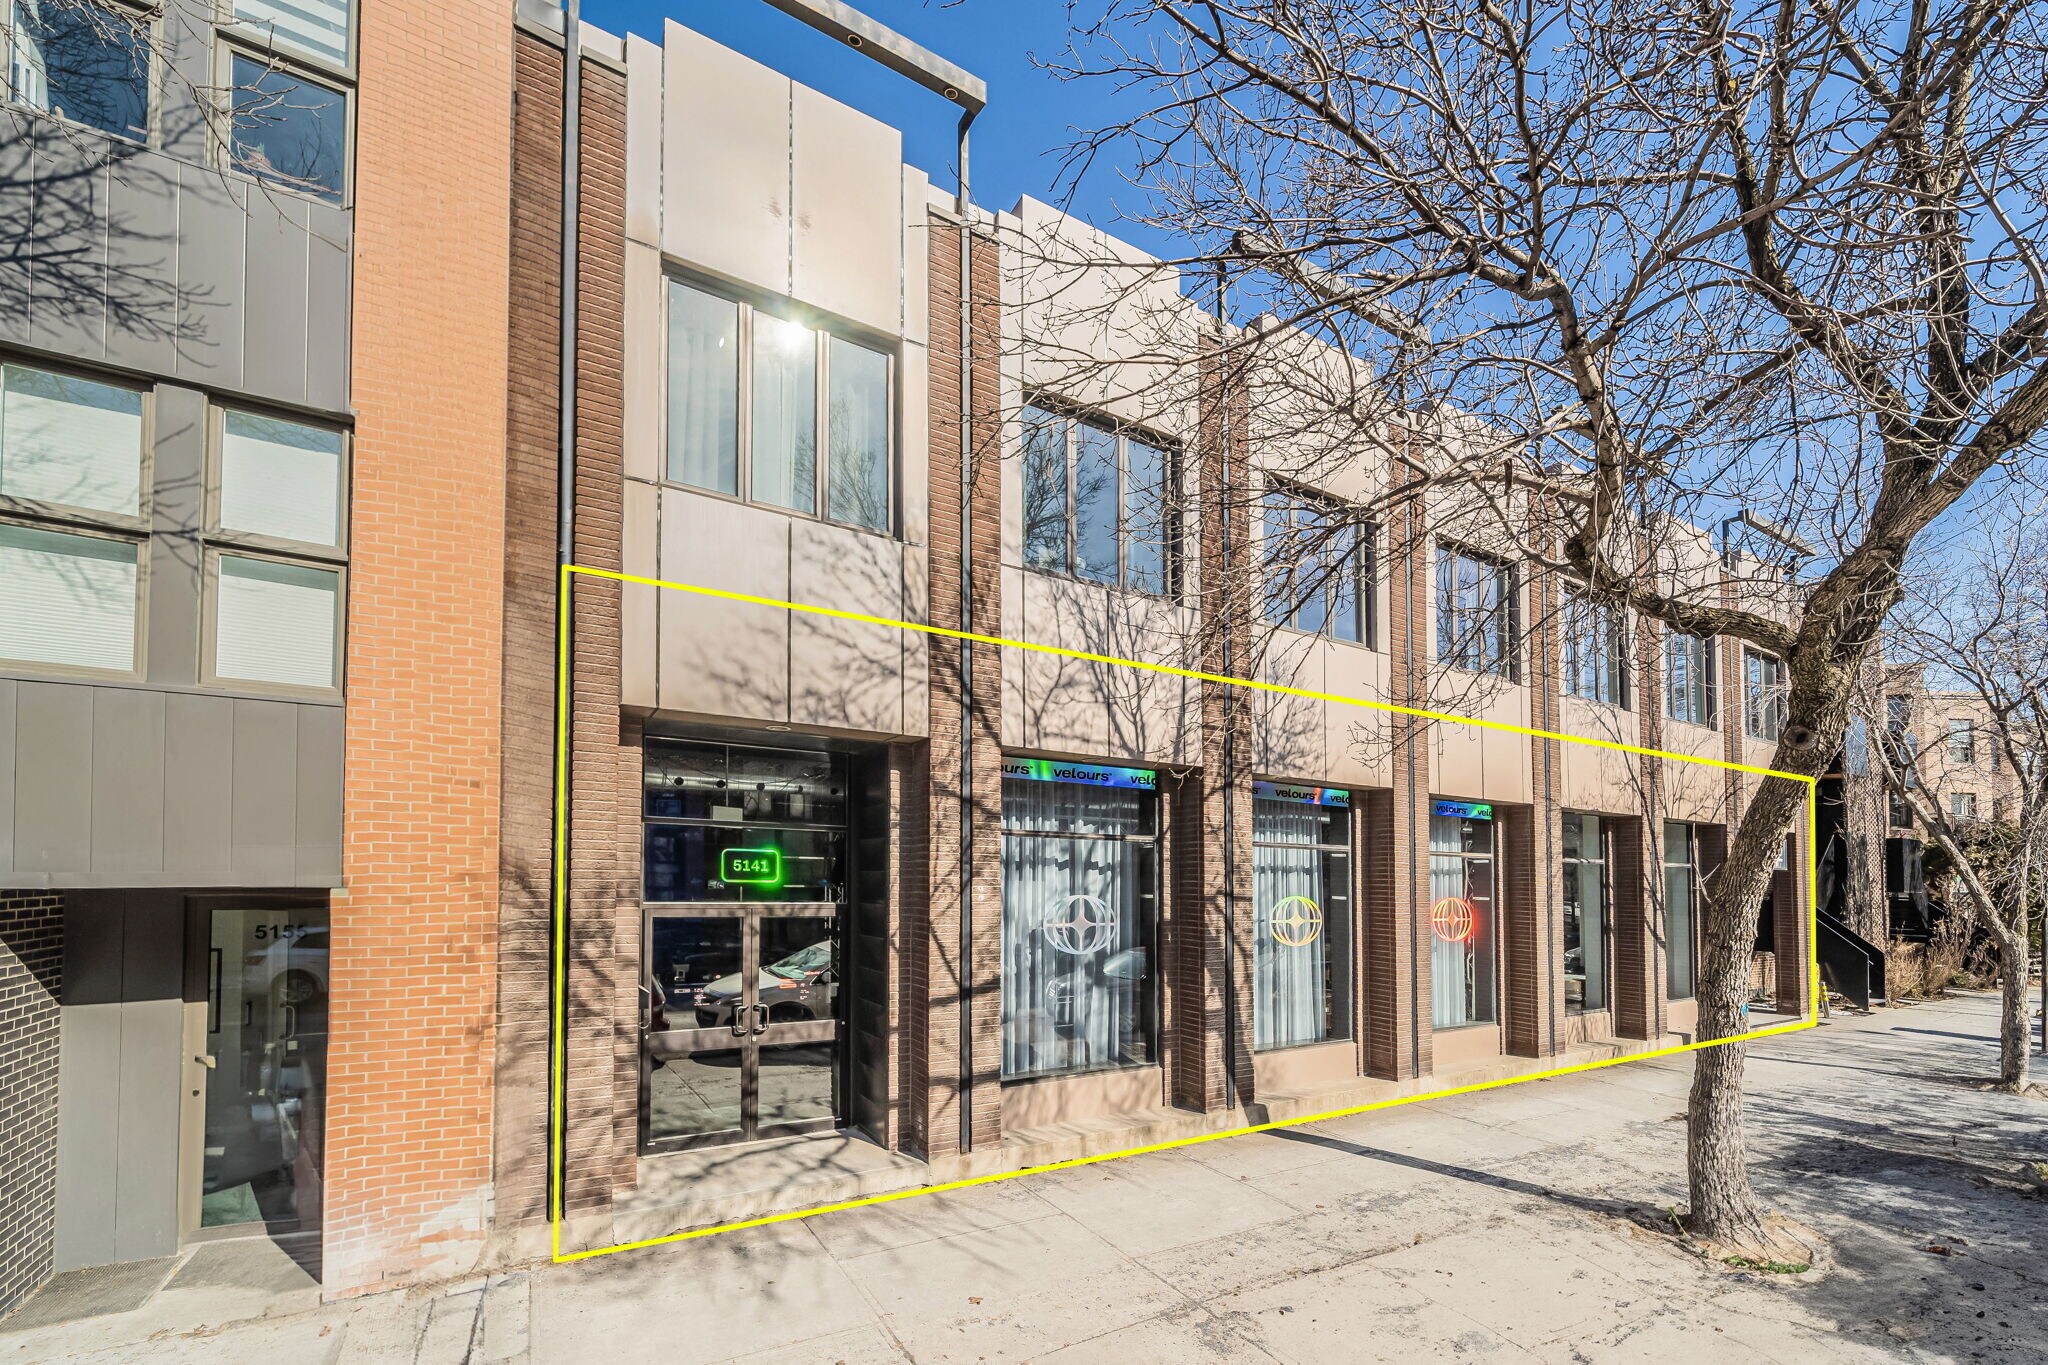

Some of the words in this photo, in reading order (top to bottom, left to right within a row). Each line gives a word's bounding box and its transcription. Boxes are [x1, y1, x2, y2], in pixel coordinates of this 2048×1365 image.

[1053, 767, 1110, 781] velours
[1275, 788, 1315, 800] velours
[733, 859, 769, 872] 5141
[254, 924, 307, 939] 5155
